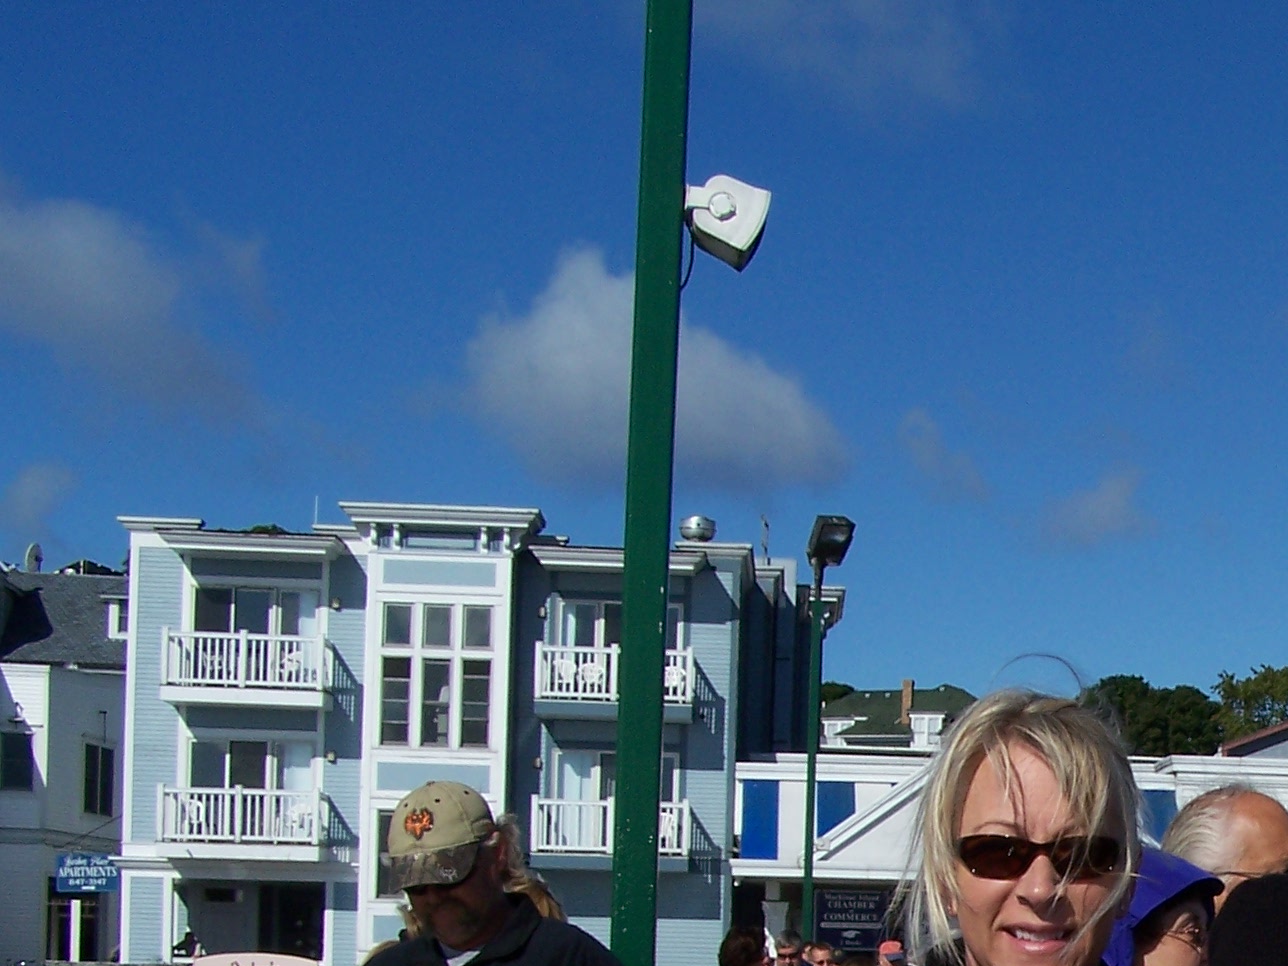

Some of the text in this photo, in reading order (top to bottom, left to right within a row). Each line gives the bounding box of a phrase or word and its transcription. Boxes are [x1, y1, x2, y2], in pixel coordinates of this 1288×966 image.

[59, 866, 117, 877] APARTMENTS
[828, 901, 875, 909] CHAMBER
[824, 913, 878, 921] COMMERCE
